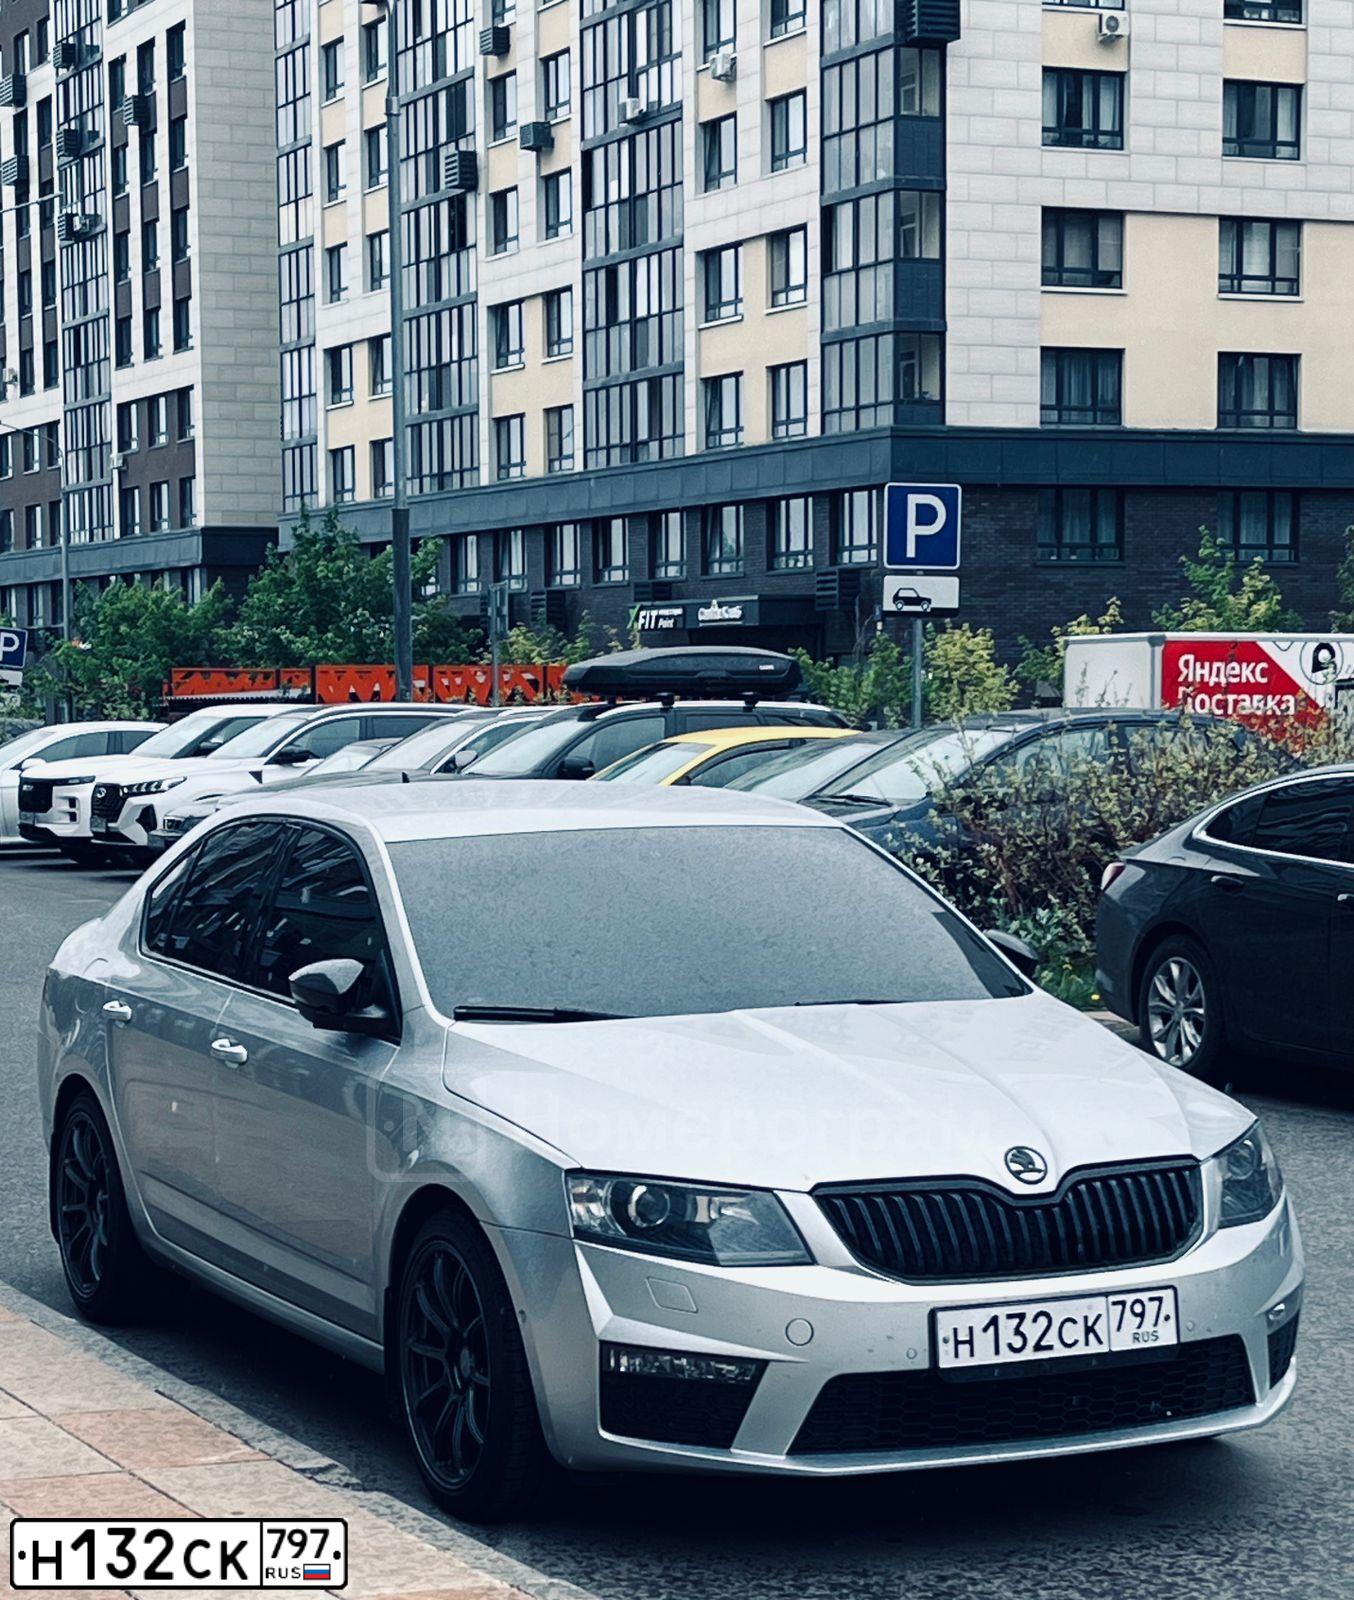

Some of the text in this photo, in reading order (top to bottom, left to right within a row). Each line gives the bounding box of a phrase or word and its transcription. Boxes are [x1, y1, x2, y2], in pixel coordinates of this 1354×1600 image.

[906, 494, 947, 558] P
[0, 632, 20, 661] P
[1177, 654, 1269, 687] Яндекс
[952, 1296, 1164, 1359] Н132СК 797
[1132, 1330, 1160, 1344] RUS
